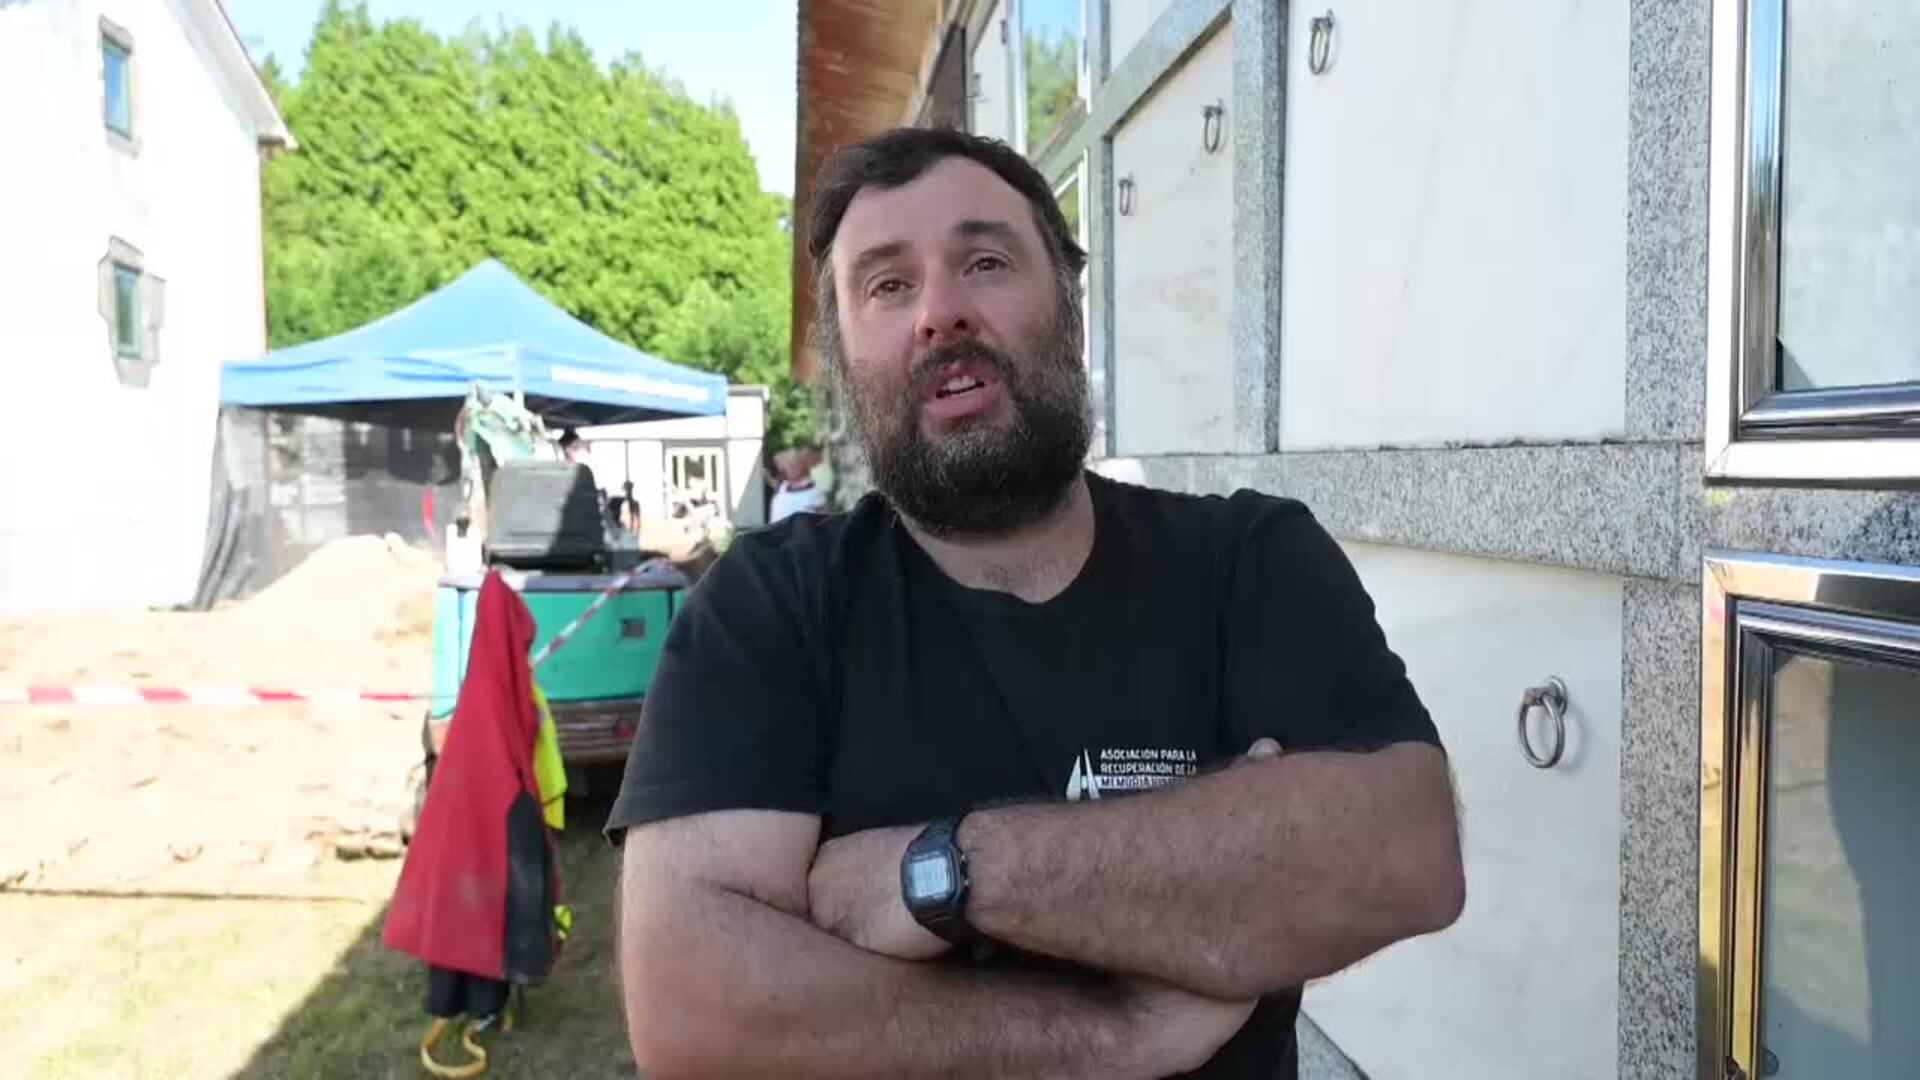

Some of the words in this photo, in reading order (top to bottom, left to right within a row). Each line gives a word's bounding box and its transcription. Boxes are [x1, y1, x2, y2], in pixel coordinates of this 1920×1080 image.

[1160, 749, 1185, 760] PARA
[1186, 750, 1197, 761] LA
[1174, 764, 1185, 775] DE
